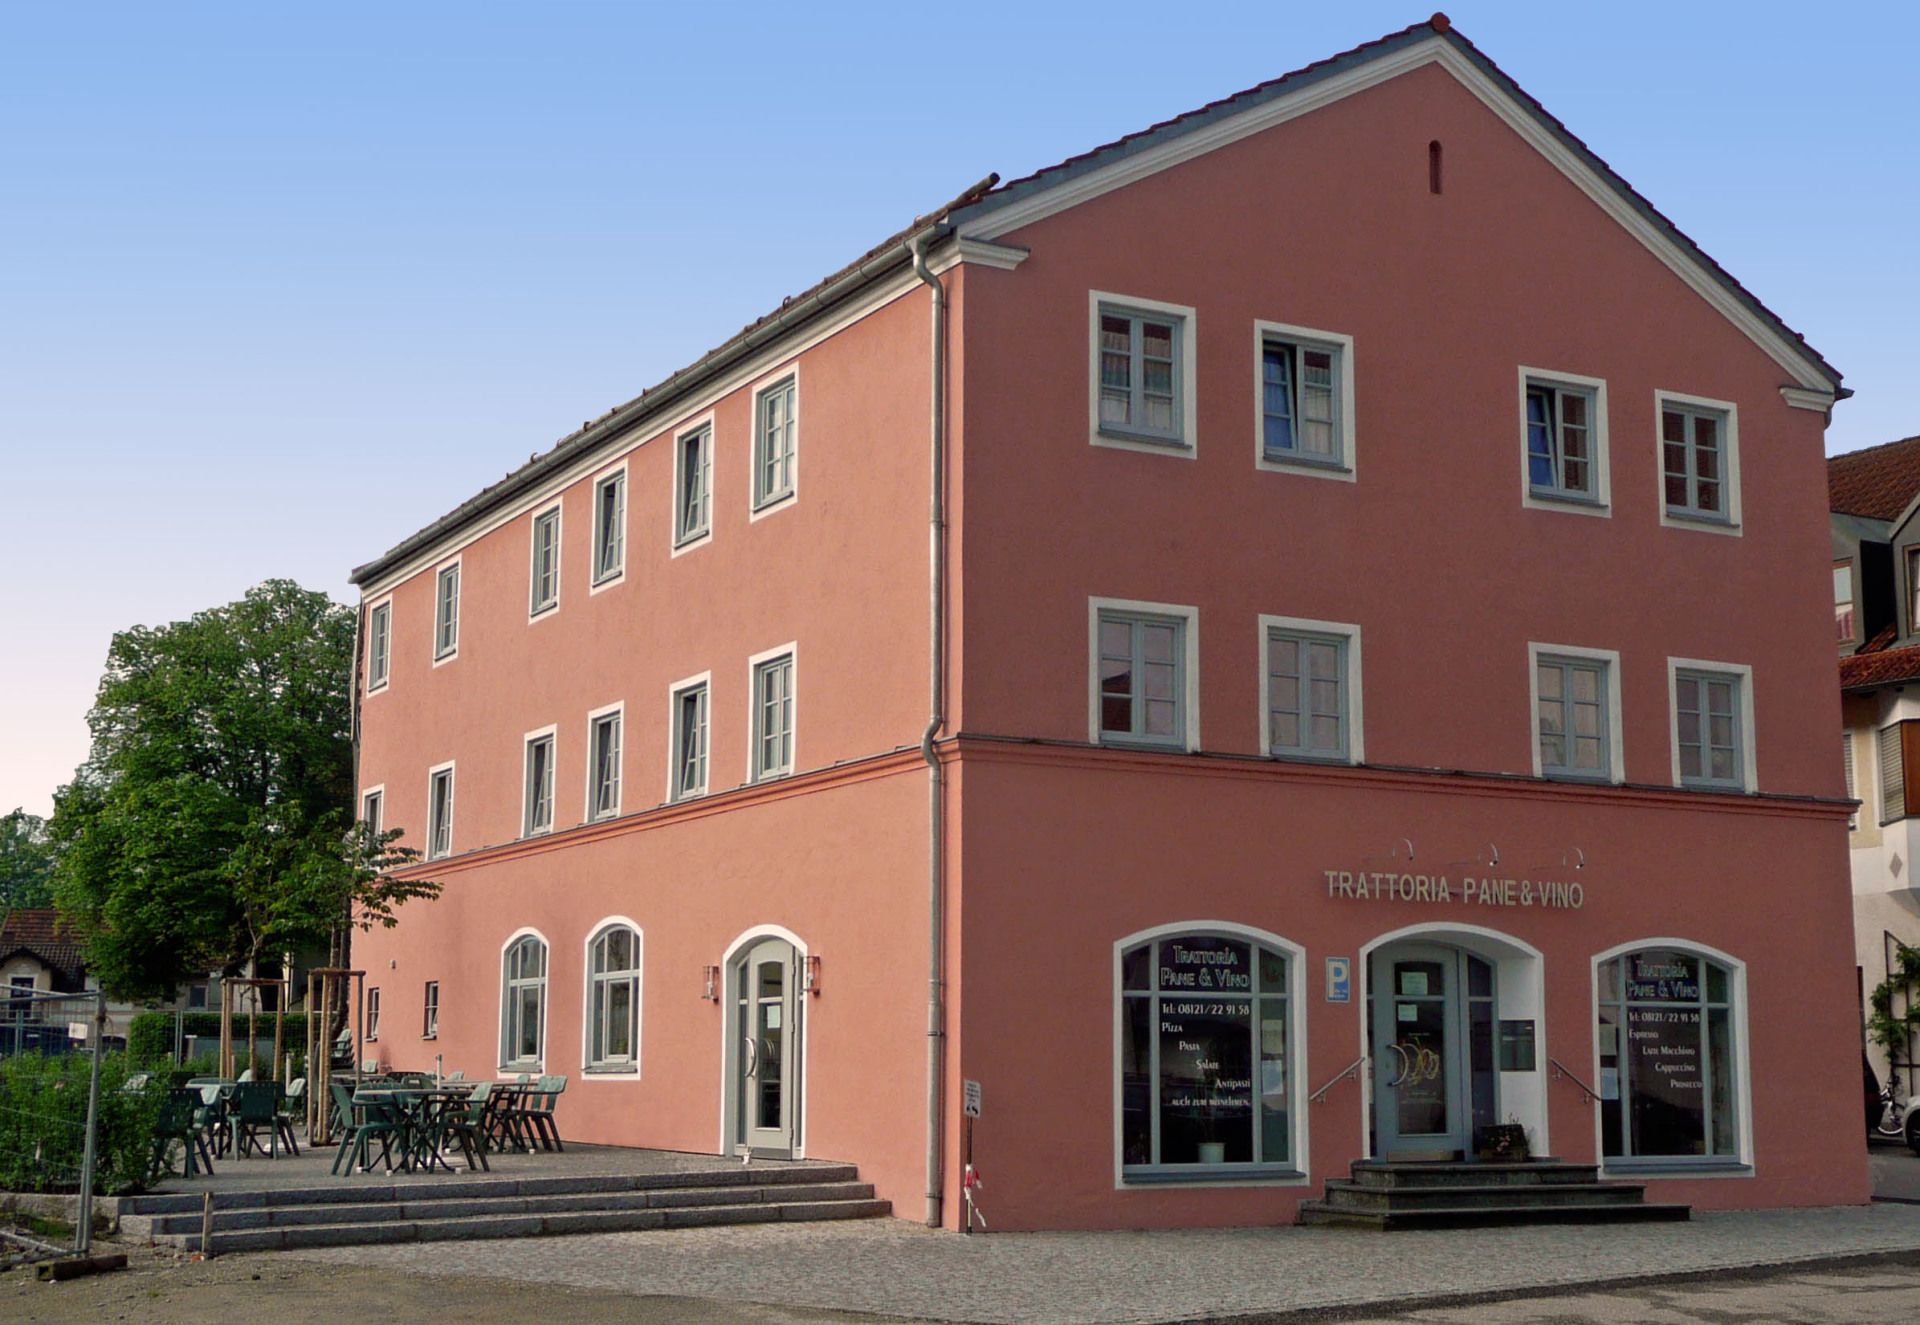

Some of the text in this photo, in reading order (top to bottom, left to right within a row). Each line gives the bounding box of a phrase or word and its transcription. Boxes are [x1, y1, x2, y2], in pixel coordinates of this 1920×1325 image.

[1324, 870, 1584, 909] TRATTORIA PANE & VINO
[1199, 967, 1213, 987] &
[1328, 961, 1347, 998] P
[1658, 980, 1669, 997] &
[1226, 1004, 1236, 1015] 91
